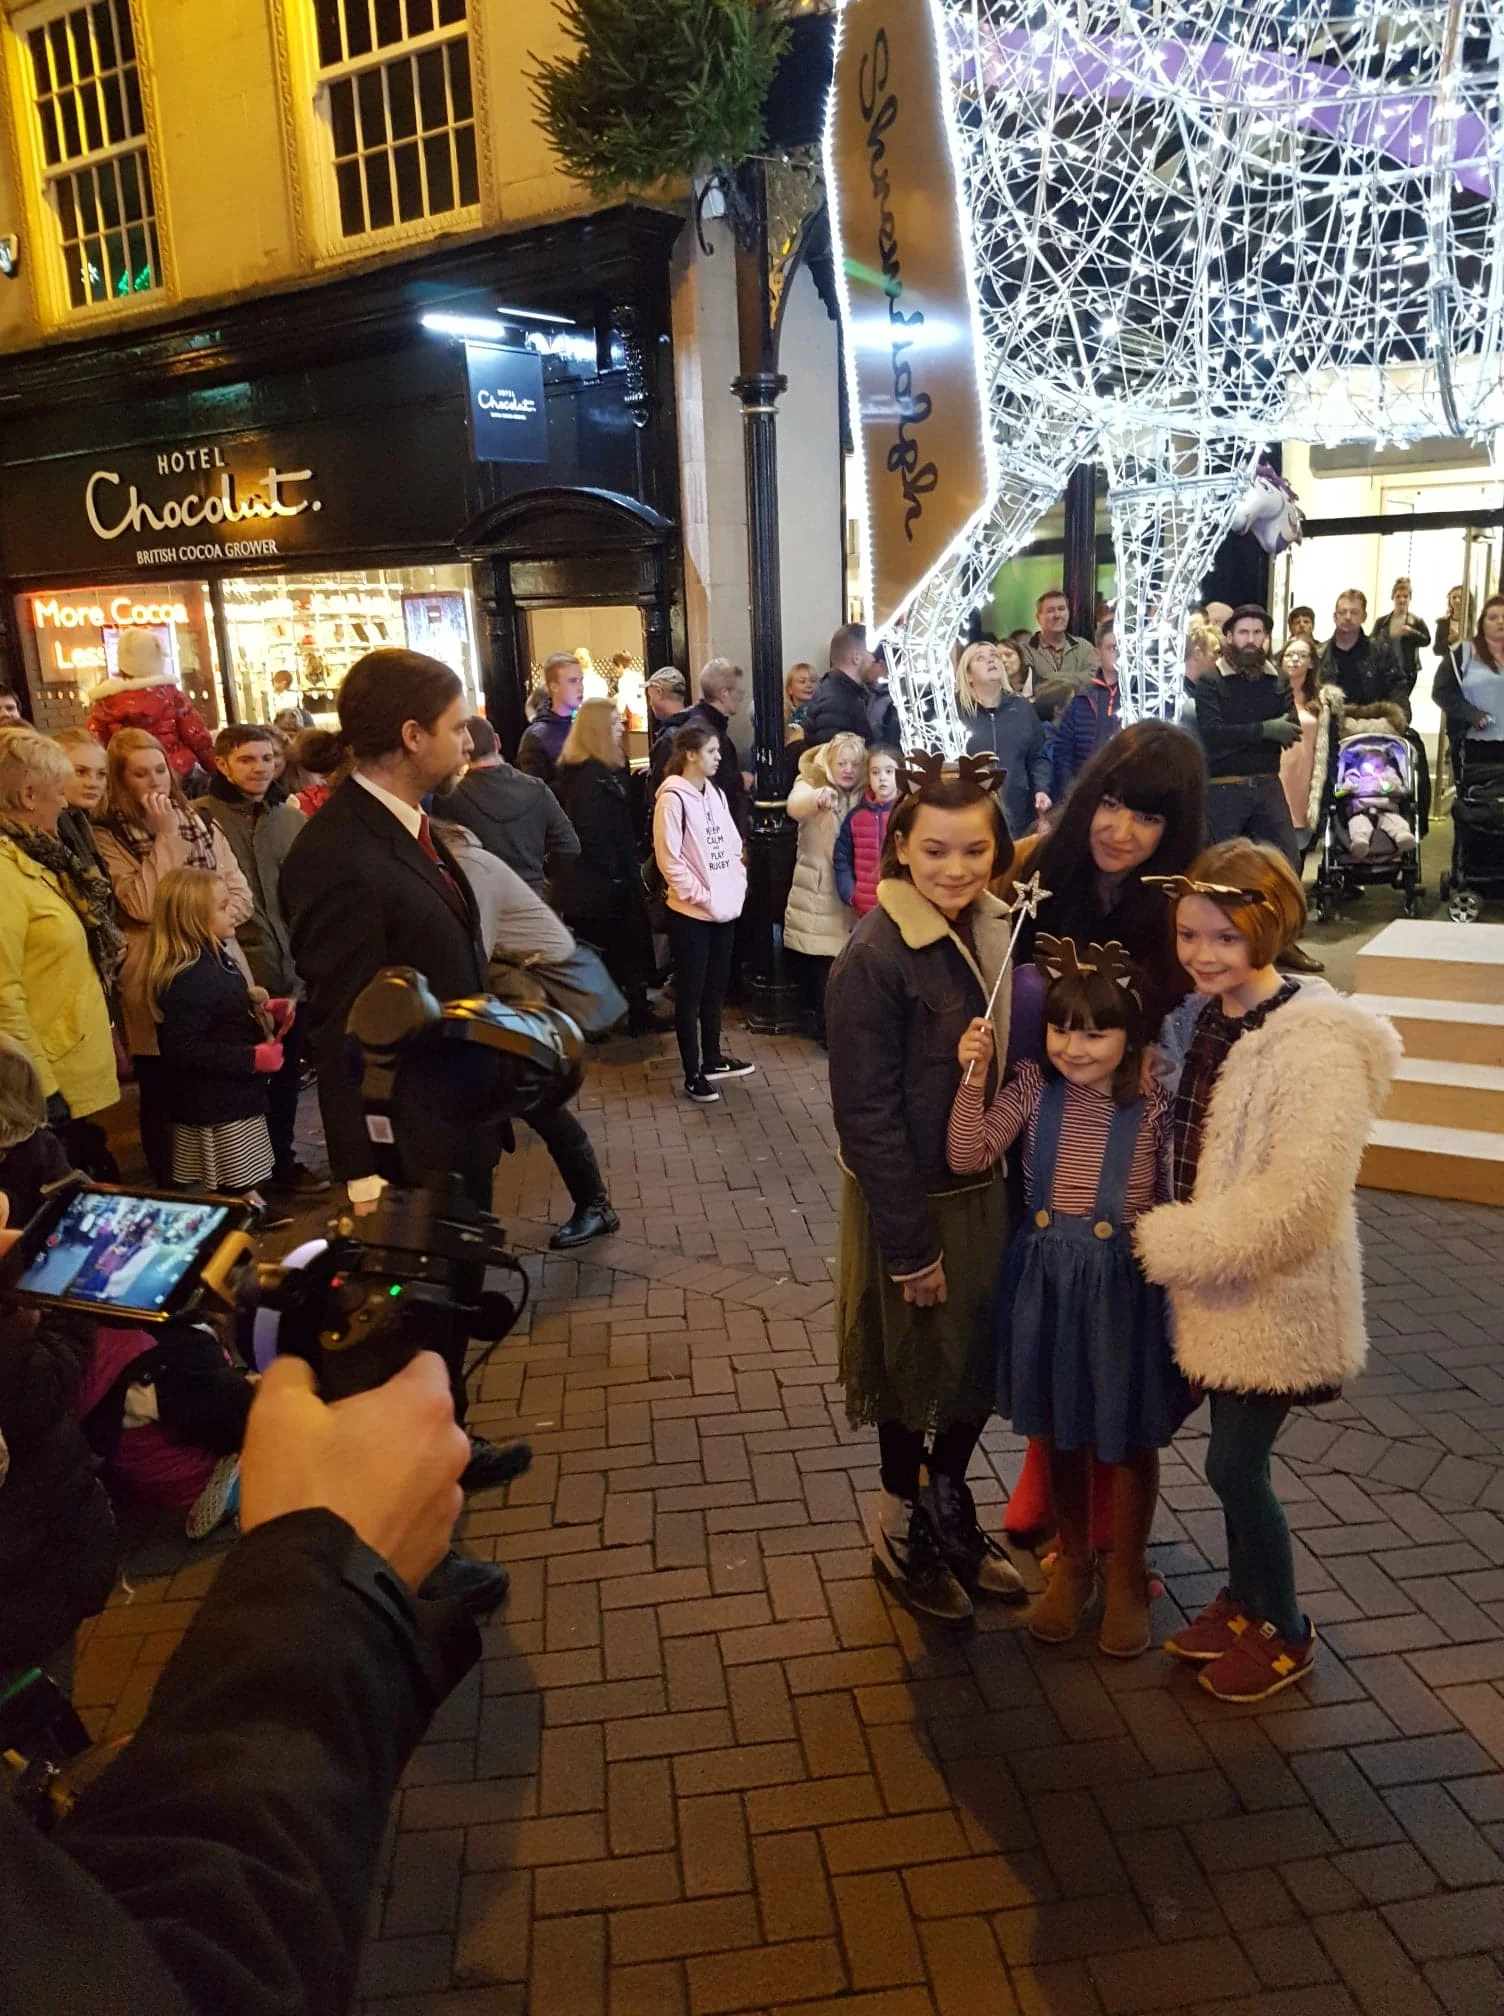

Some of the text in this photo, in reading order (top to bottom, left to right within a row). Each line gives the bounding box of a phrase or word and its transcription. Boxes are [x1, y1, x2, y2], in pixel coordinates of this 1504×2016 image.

[157, 447, 225, 475] HOTEL
[136, 539, 278, 565] BRITISH COCOA GROWER
[34, 596, 189, 628] More Cocoa
[706, 835, 724, 845] CALM
[710, 850, 724, 860] PLAY
